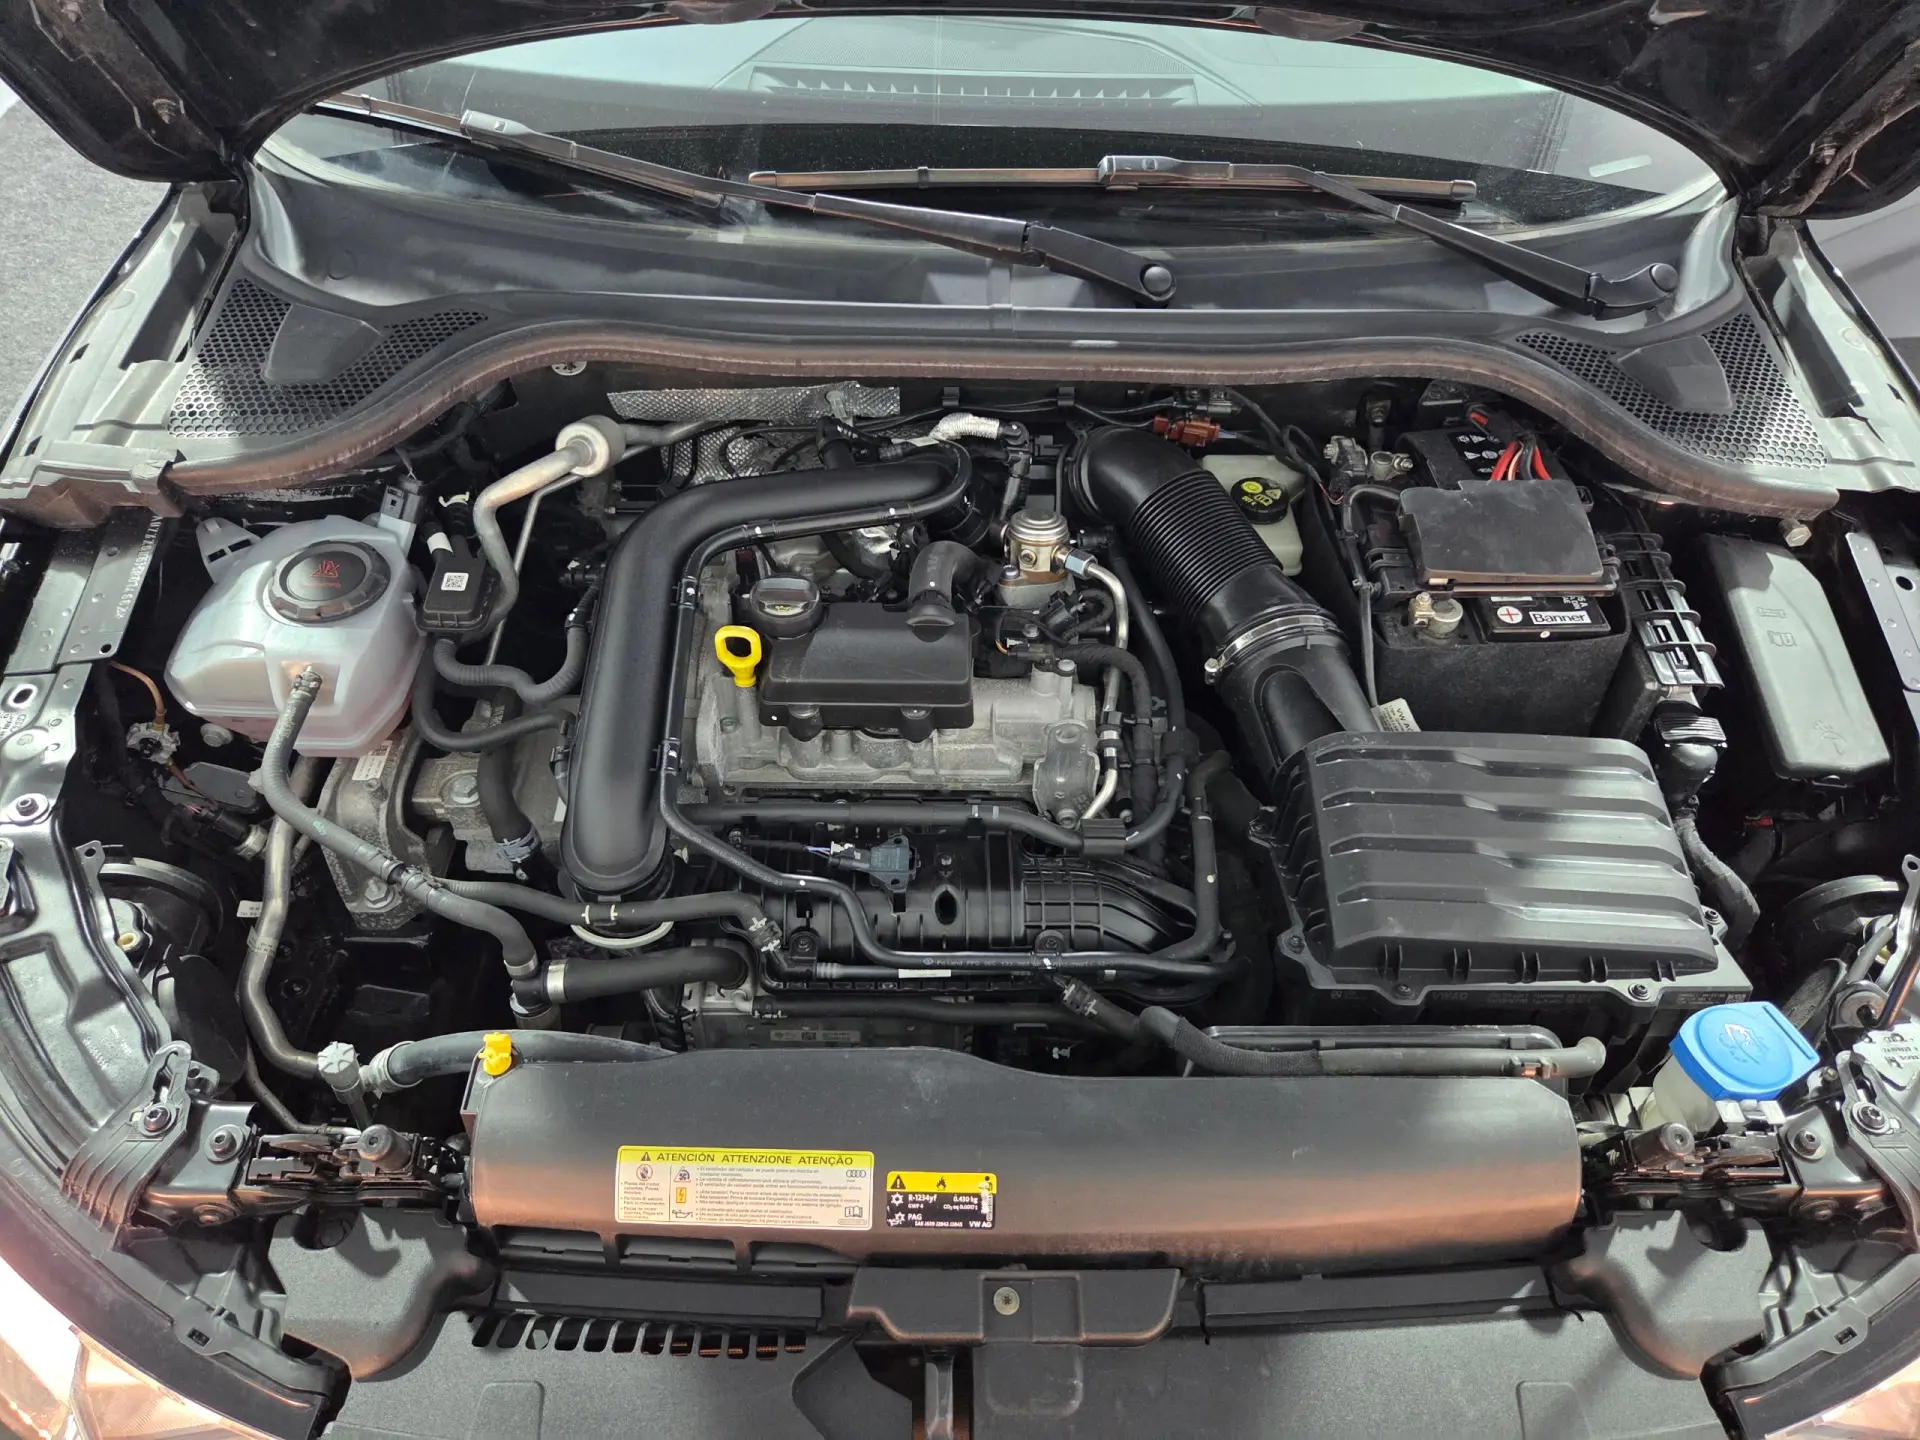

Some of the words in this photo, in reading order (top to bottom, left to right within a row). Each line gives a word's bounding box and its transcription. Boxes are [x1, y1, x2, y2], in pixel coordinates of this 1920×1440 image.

[1533, 613, 1586, 623] Banner
[657, 1152, 715, 1162] ATENCIÓN
[721, 1154, 792, 1164] ATTENZIONE
[798, 1155, 853, 1167] ATENÇÃO
[908, 1194, 937, 1203] R-1234yf
[970, 1196, 979, 1204] kg
